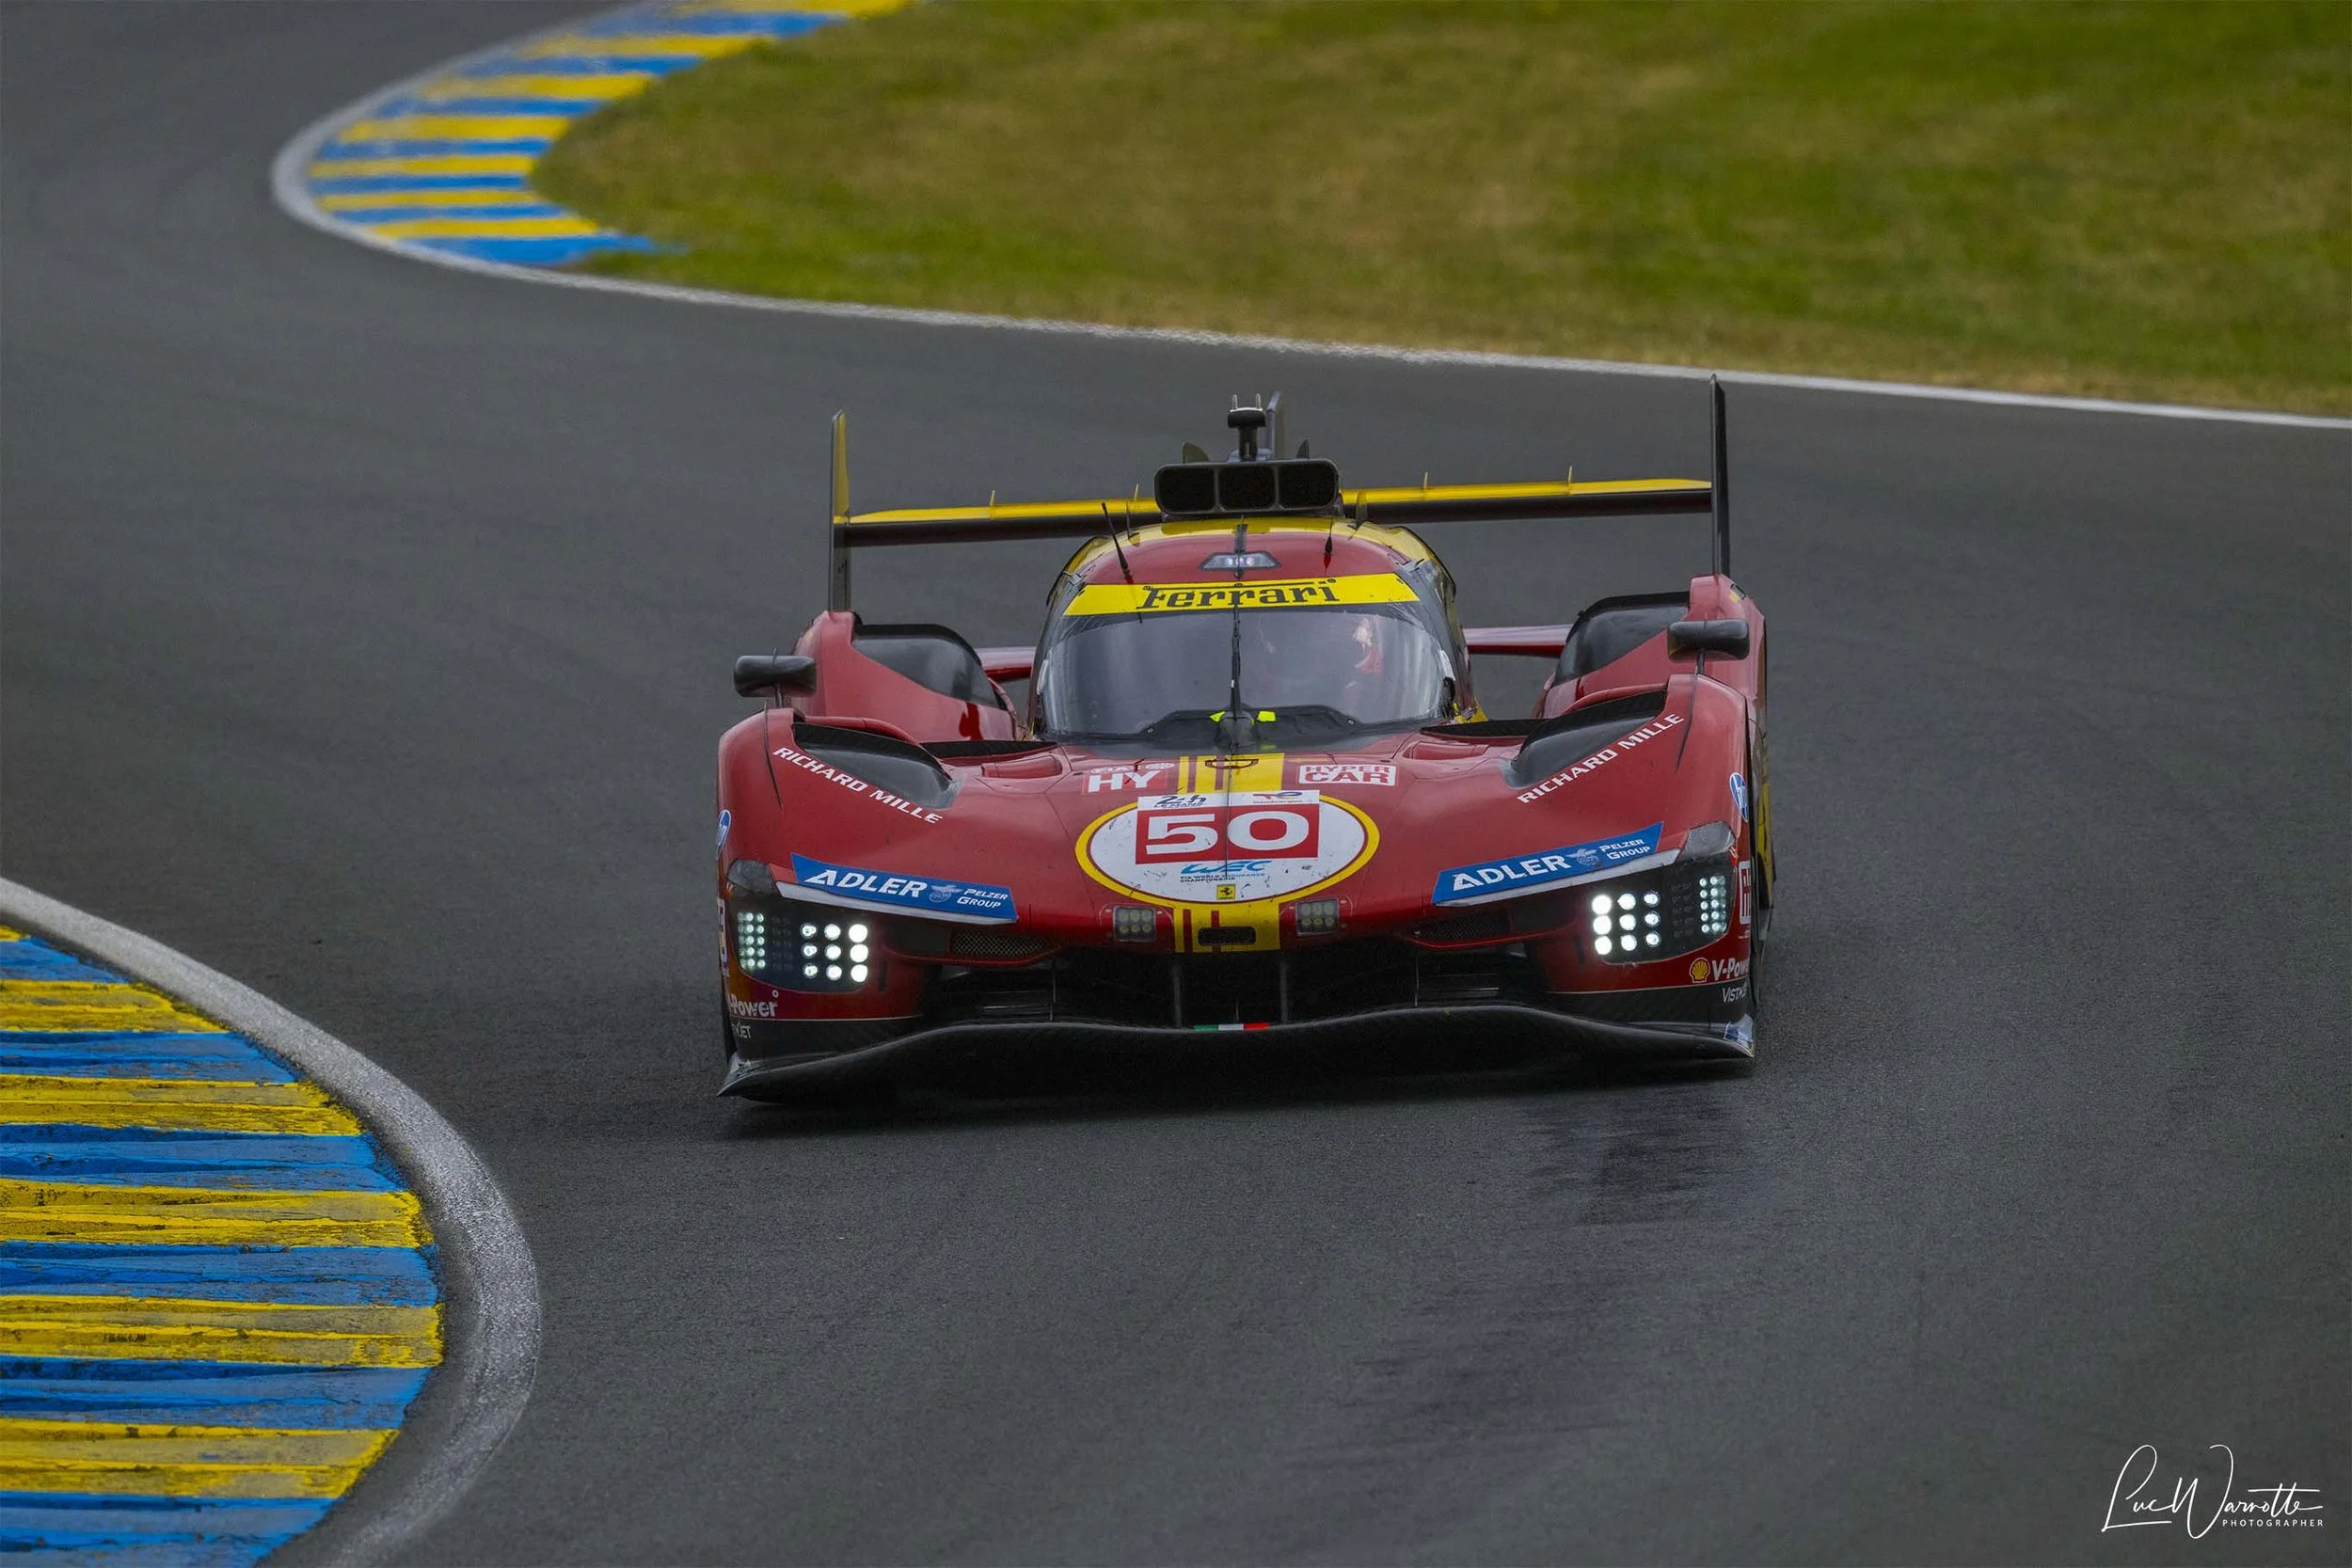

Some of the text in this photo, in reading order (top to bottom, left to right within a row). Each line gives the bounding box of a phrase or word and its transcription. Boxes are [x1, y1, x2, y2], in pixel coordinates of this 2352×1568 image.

[1136, 578, 1340, 610] Ferrari
[1517, 714, 1685, 803] RICHARD MILLE
[773, 747, 943, 824] RICHARD MILLE
[1089, 770, 1161, 793] HY
[1305, 771, 1389, 784] CAR
[1146, 811, 1309, 855] 50
[1599, 839, 1645, 852] PELZER
[1607, 846, 1651, 860] GROUP
[1181, 860, 1272, 874] WEC
[1452, 855, 1572, 891] ADLER
[804, 869, 928, 897] ADLER
[962, 888, 1009, 900] PELZER
[957, 896, 1002, 909] GROUP
